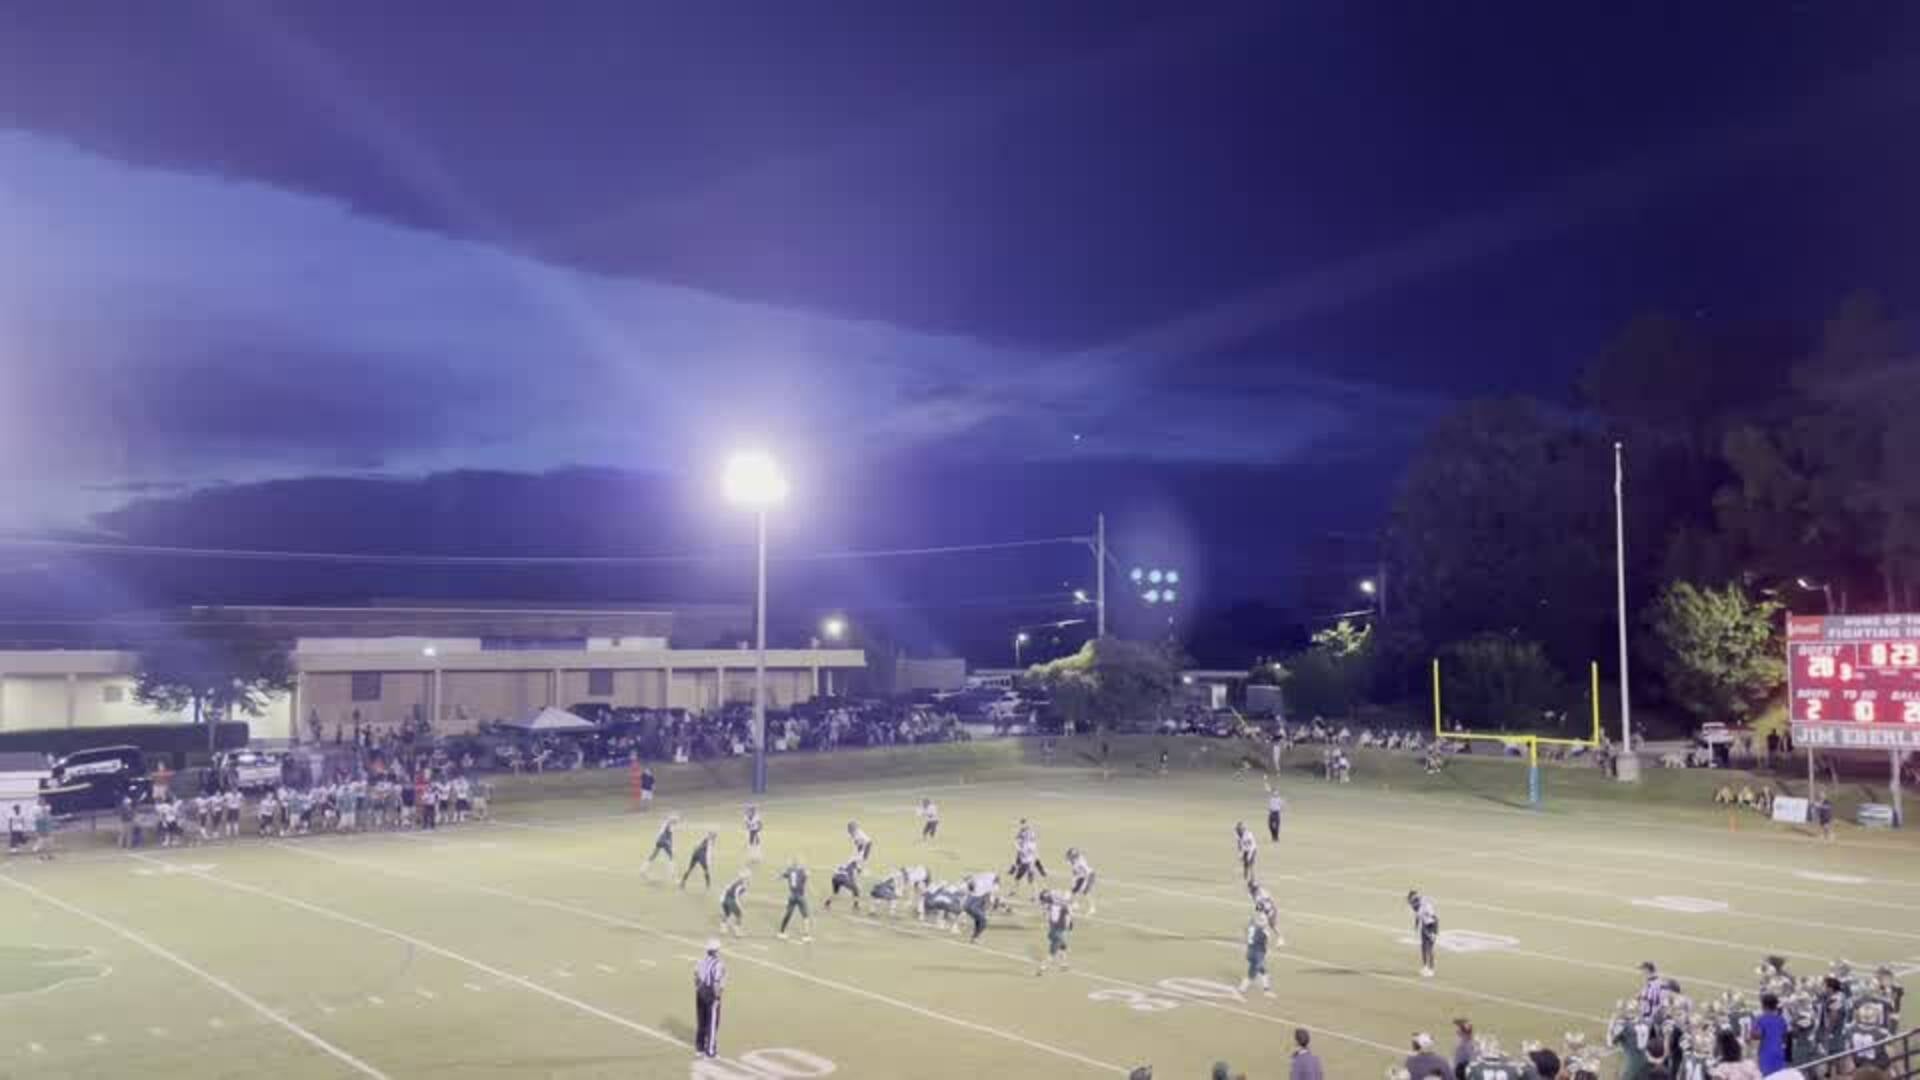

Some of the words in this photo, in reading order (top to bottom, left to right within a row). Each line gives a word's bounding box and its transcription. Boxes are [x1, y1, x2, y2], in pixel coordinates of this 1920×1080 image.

[1828, 627, 1900, 638] FIGHTING
[1807, 698, 1822, 720] 2
[1903, 701, 1920, 723] 2
[1797, 728, 1834, 743] JIM
